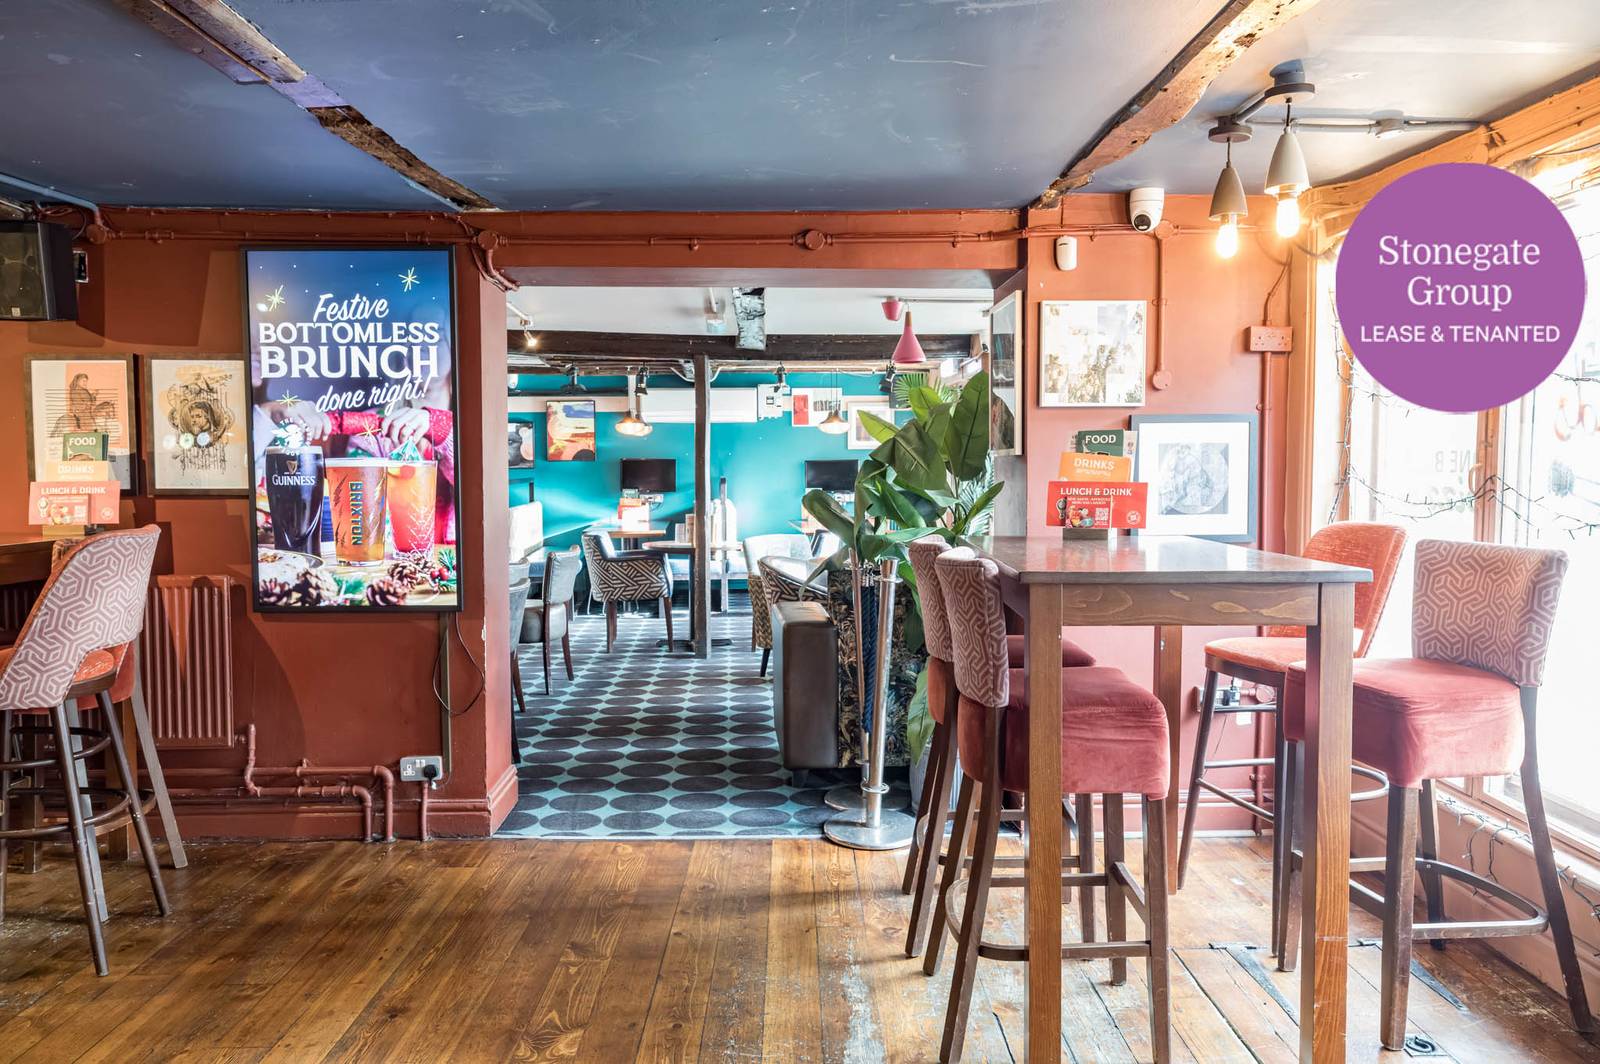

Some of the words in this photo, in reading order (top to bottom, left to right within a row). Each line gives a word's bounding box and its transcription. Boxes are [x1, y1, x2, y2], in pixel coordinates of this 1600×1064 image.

[313, 293, 389, 322] Festive
[259, 322, 440, 344] BOTTOMLESS
[260, 345, 439, 379] BRUNCH
[315, 385, 365, 413] done
[368, 375, 429, 415] right!
[69, 437, 96, 446] FOOD
[1085, 435, 1116, 444] FOOD
[58, 464, 93, 473] DRINKS
[1074, 458, 1115, 469] DRINKS
[272, 474, 316, 486] GUINNESS
[41, 487, 69, 495] LUNCH
[79, 486, 106, 495] DRINK
[1060, 487, 1092, 496] LUNCH
[1094, 487, 1101, 496] &
[1103, 487, 1132, 497] DRINK
[349, 481, 363, 546] BRIXTON
